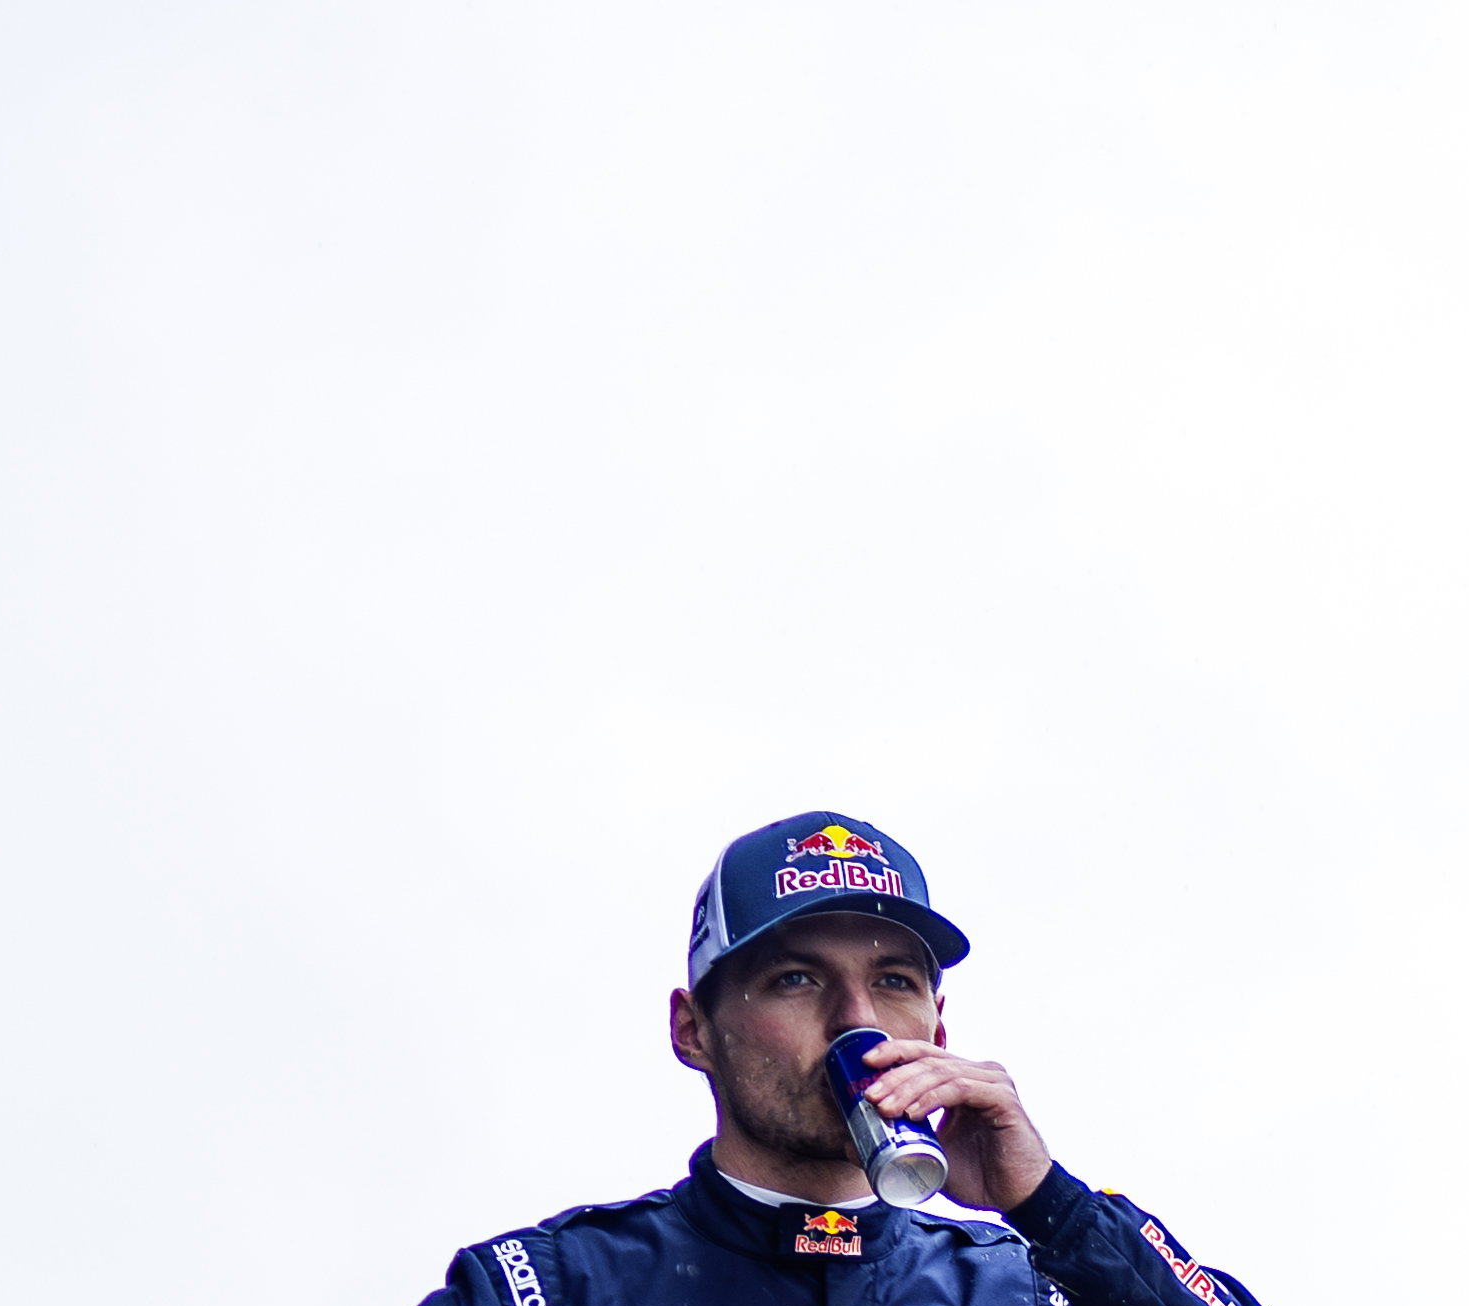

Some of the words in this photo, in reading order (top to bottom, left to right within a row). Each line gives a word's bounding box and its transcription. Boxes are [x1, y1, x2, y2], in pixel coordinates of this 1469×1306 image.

[775, 861, 847, 899] Red
[845, 861, 905, 898] Bull
[794, 1232, 830, 1255] Red
[830, 1233, 862, 1257] Bull
